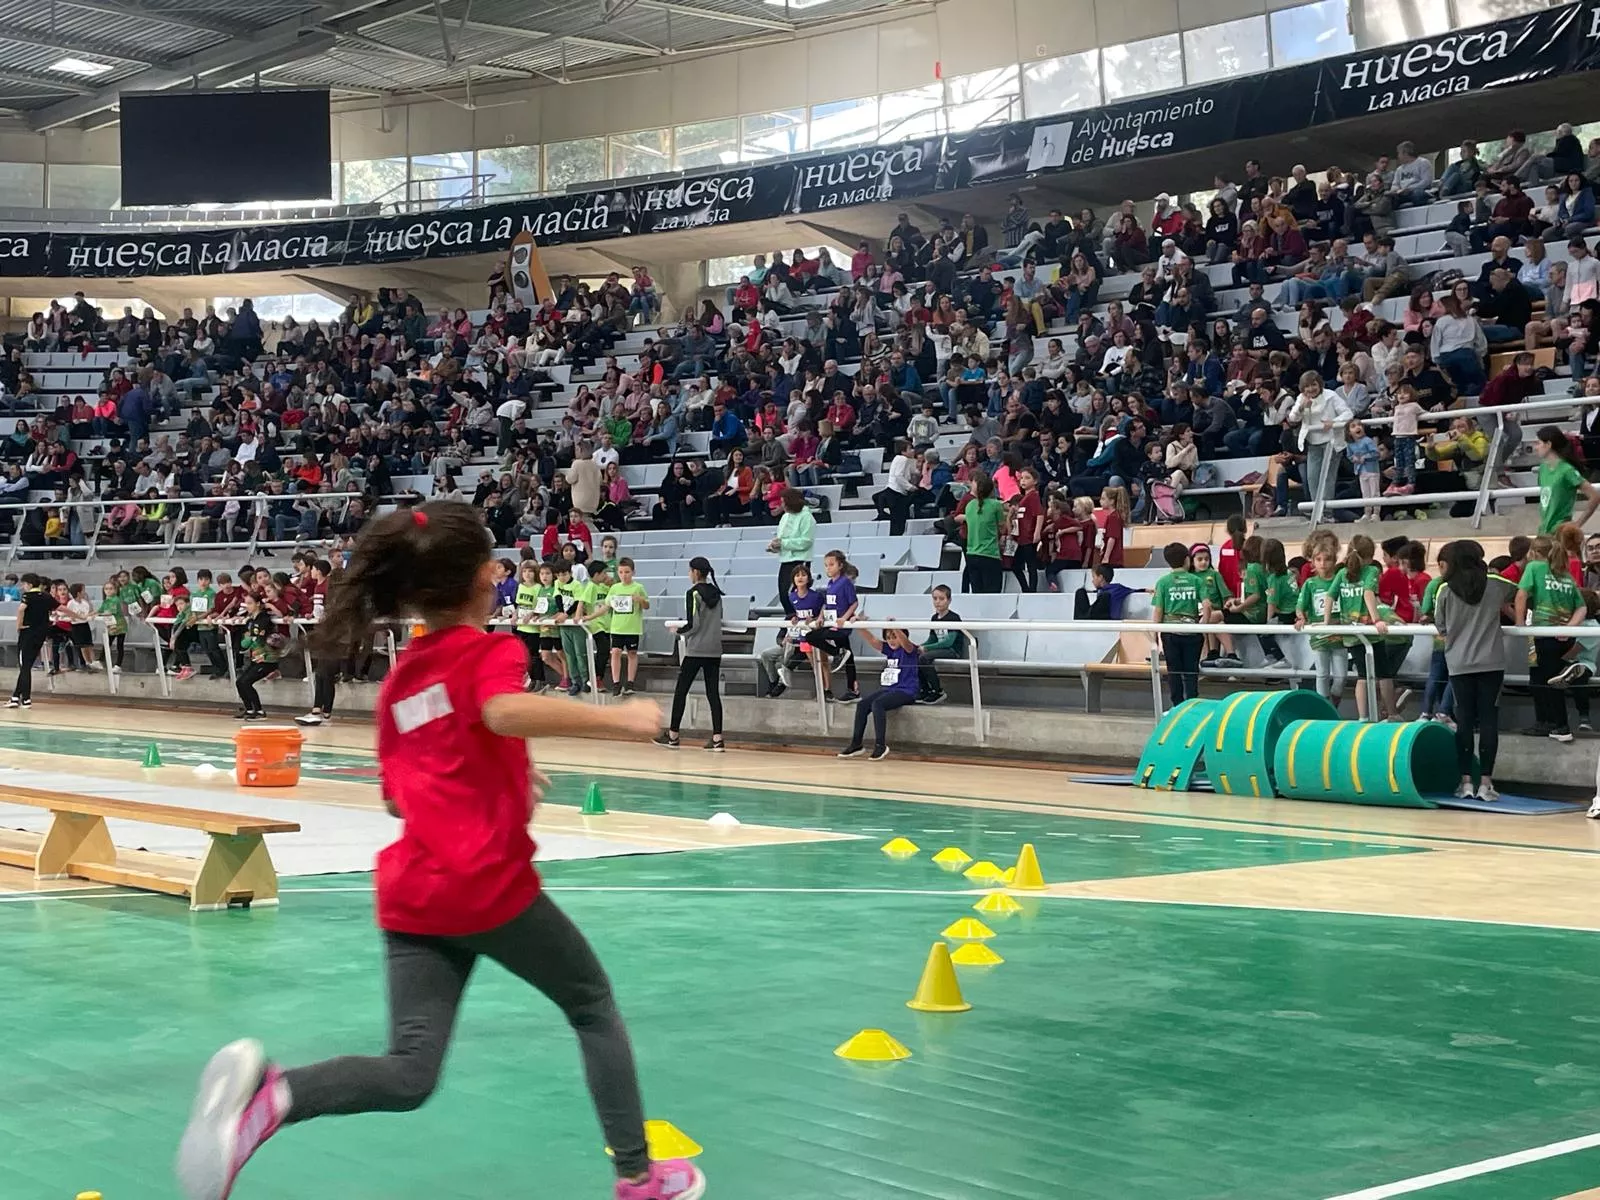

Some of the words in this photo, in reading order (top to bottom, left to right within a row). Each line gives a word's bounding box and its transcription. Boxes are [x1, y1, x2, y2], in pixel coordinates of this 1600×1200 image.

[1076, 96, 1214, 144] Ayuntamiento
[1071, 142, 1094, 165] de
[1100, 129, 1175, 160] Huesca
